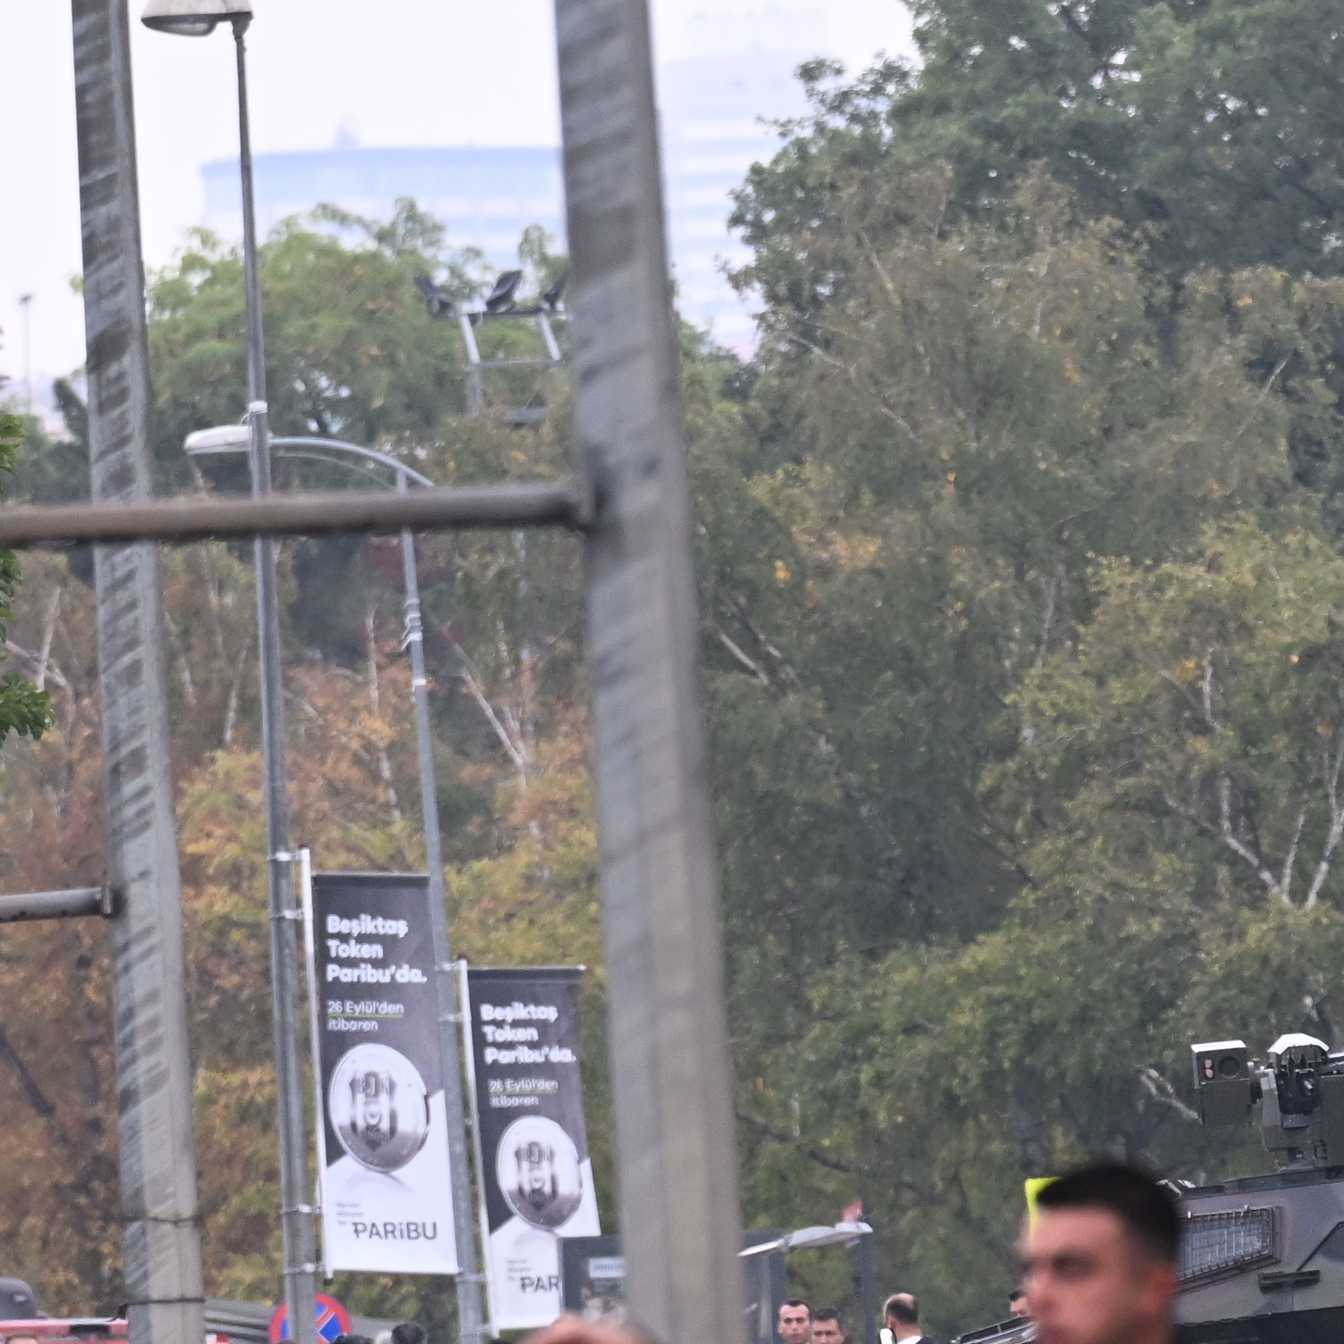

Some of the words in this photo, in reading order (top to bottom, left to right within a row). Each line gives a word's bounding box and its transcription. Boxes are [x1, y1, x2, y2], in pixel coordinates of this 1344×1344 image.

[326, 914, 408, 938] Beşiktaş
[326, 939, 383, 958] Token
[326, 963, 428, 983] Paribu'da.
[328, 1001, 343, 1012] 26
[482, 1025, 539, 1042] Token
